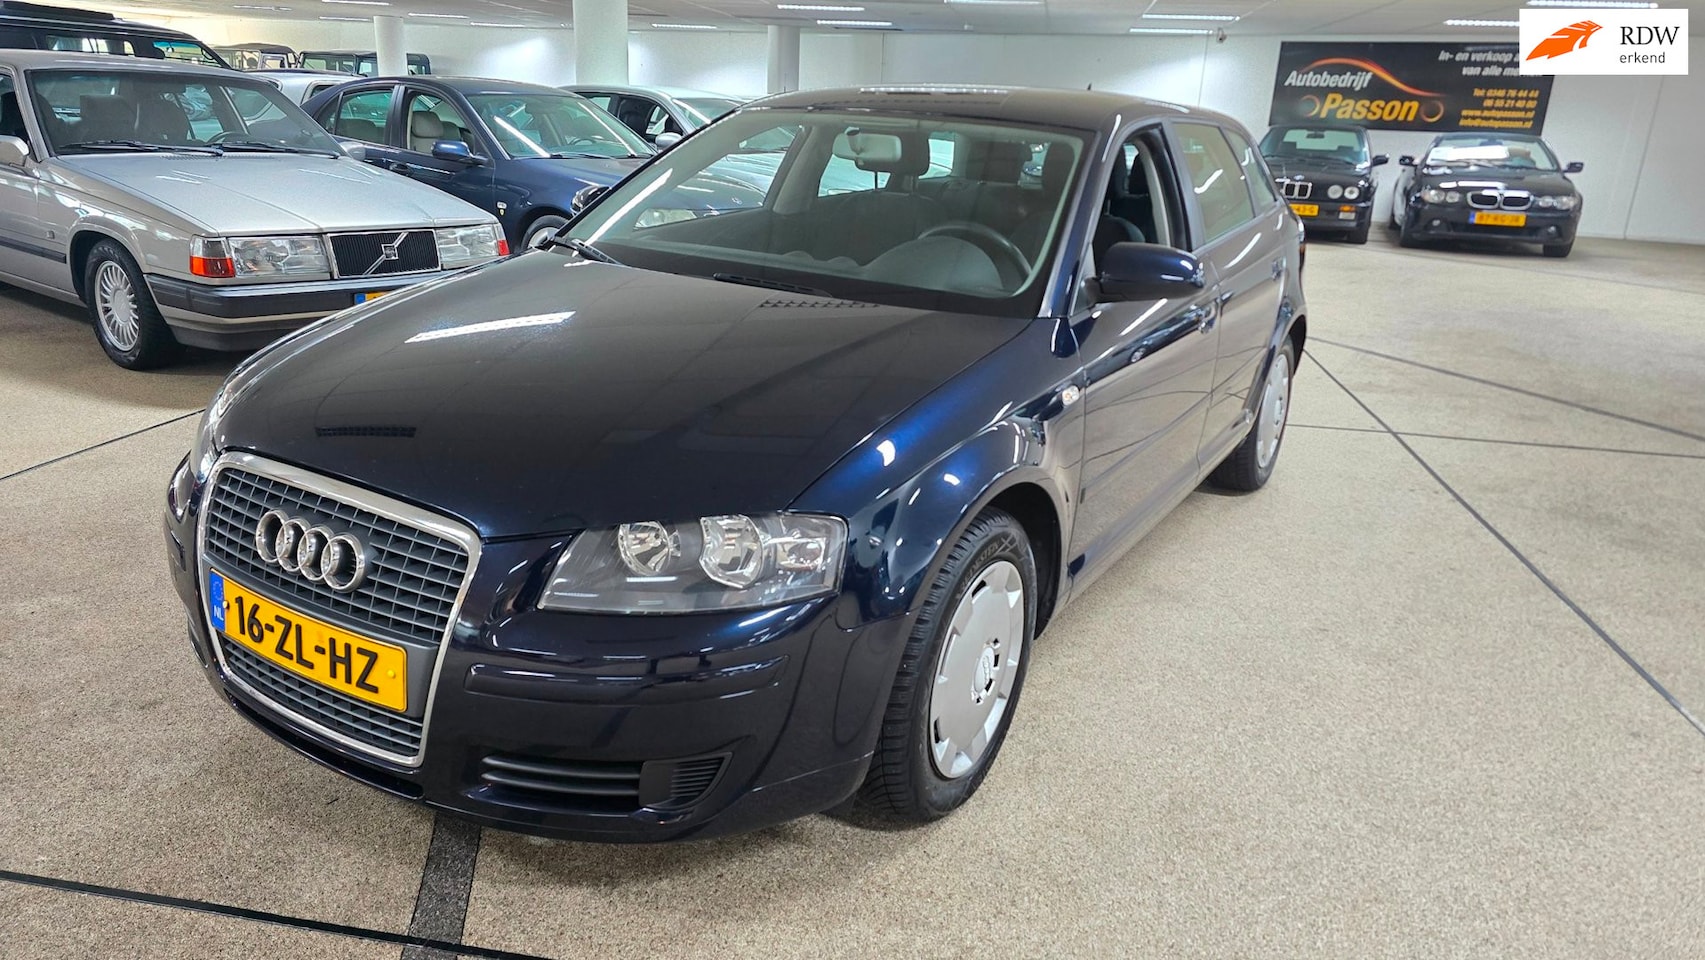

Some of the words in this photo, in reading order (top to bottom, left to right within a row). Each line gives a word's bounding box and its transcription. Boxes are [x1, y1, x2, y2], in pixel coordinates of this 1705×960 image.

[1438, 50, 1454, 61] In-
[1455, 52, 1470, 61] en
[1470, 50, 1513, 64] verkoop
[1462, 66, 1482, 76] van
[1482, 65, 1503, 76] alle
[1284, 70, 1373, 91] Autobedrijf
[1319, 92, 1420, 122] Passon
[214, 605, 224, 621] NL
[234, 596, 378, 694] 16-ZL-HZ
